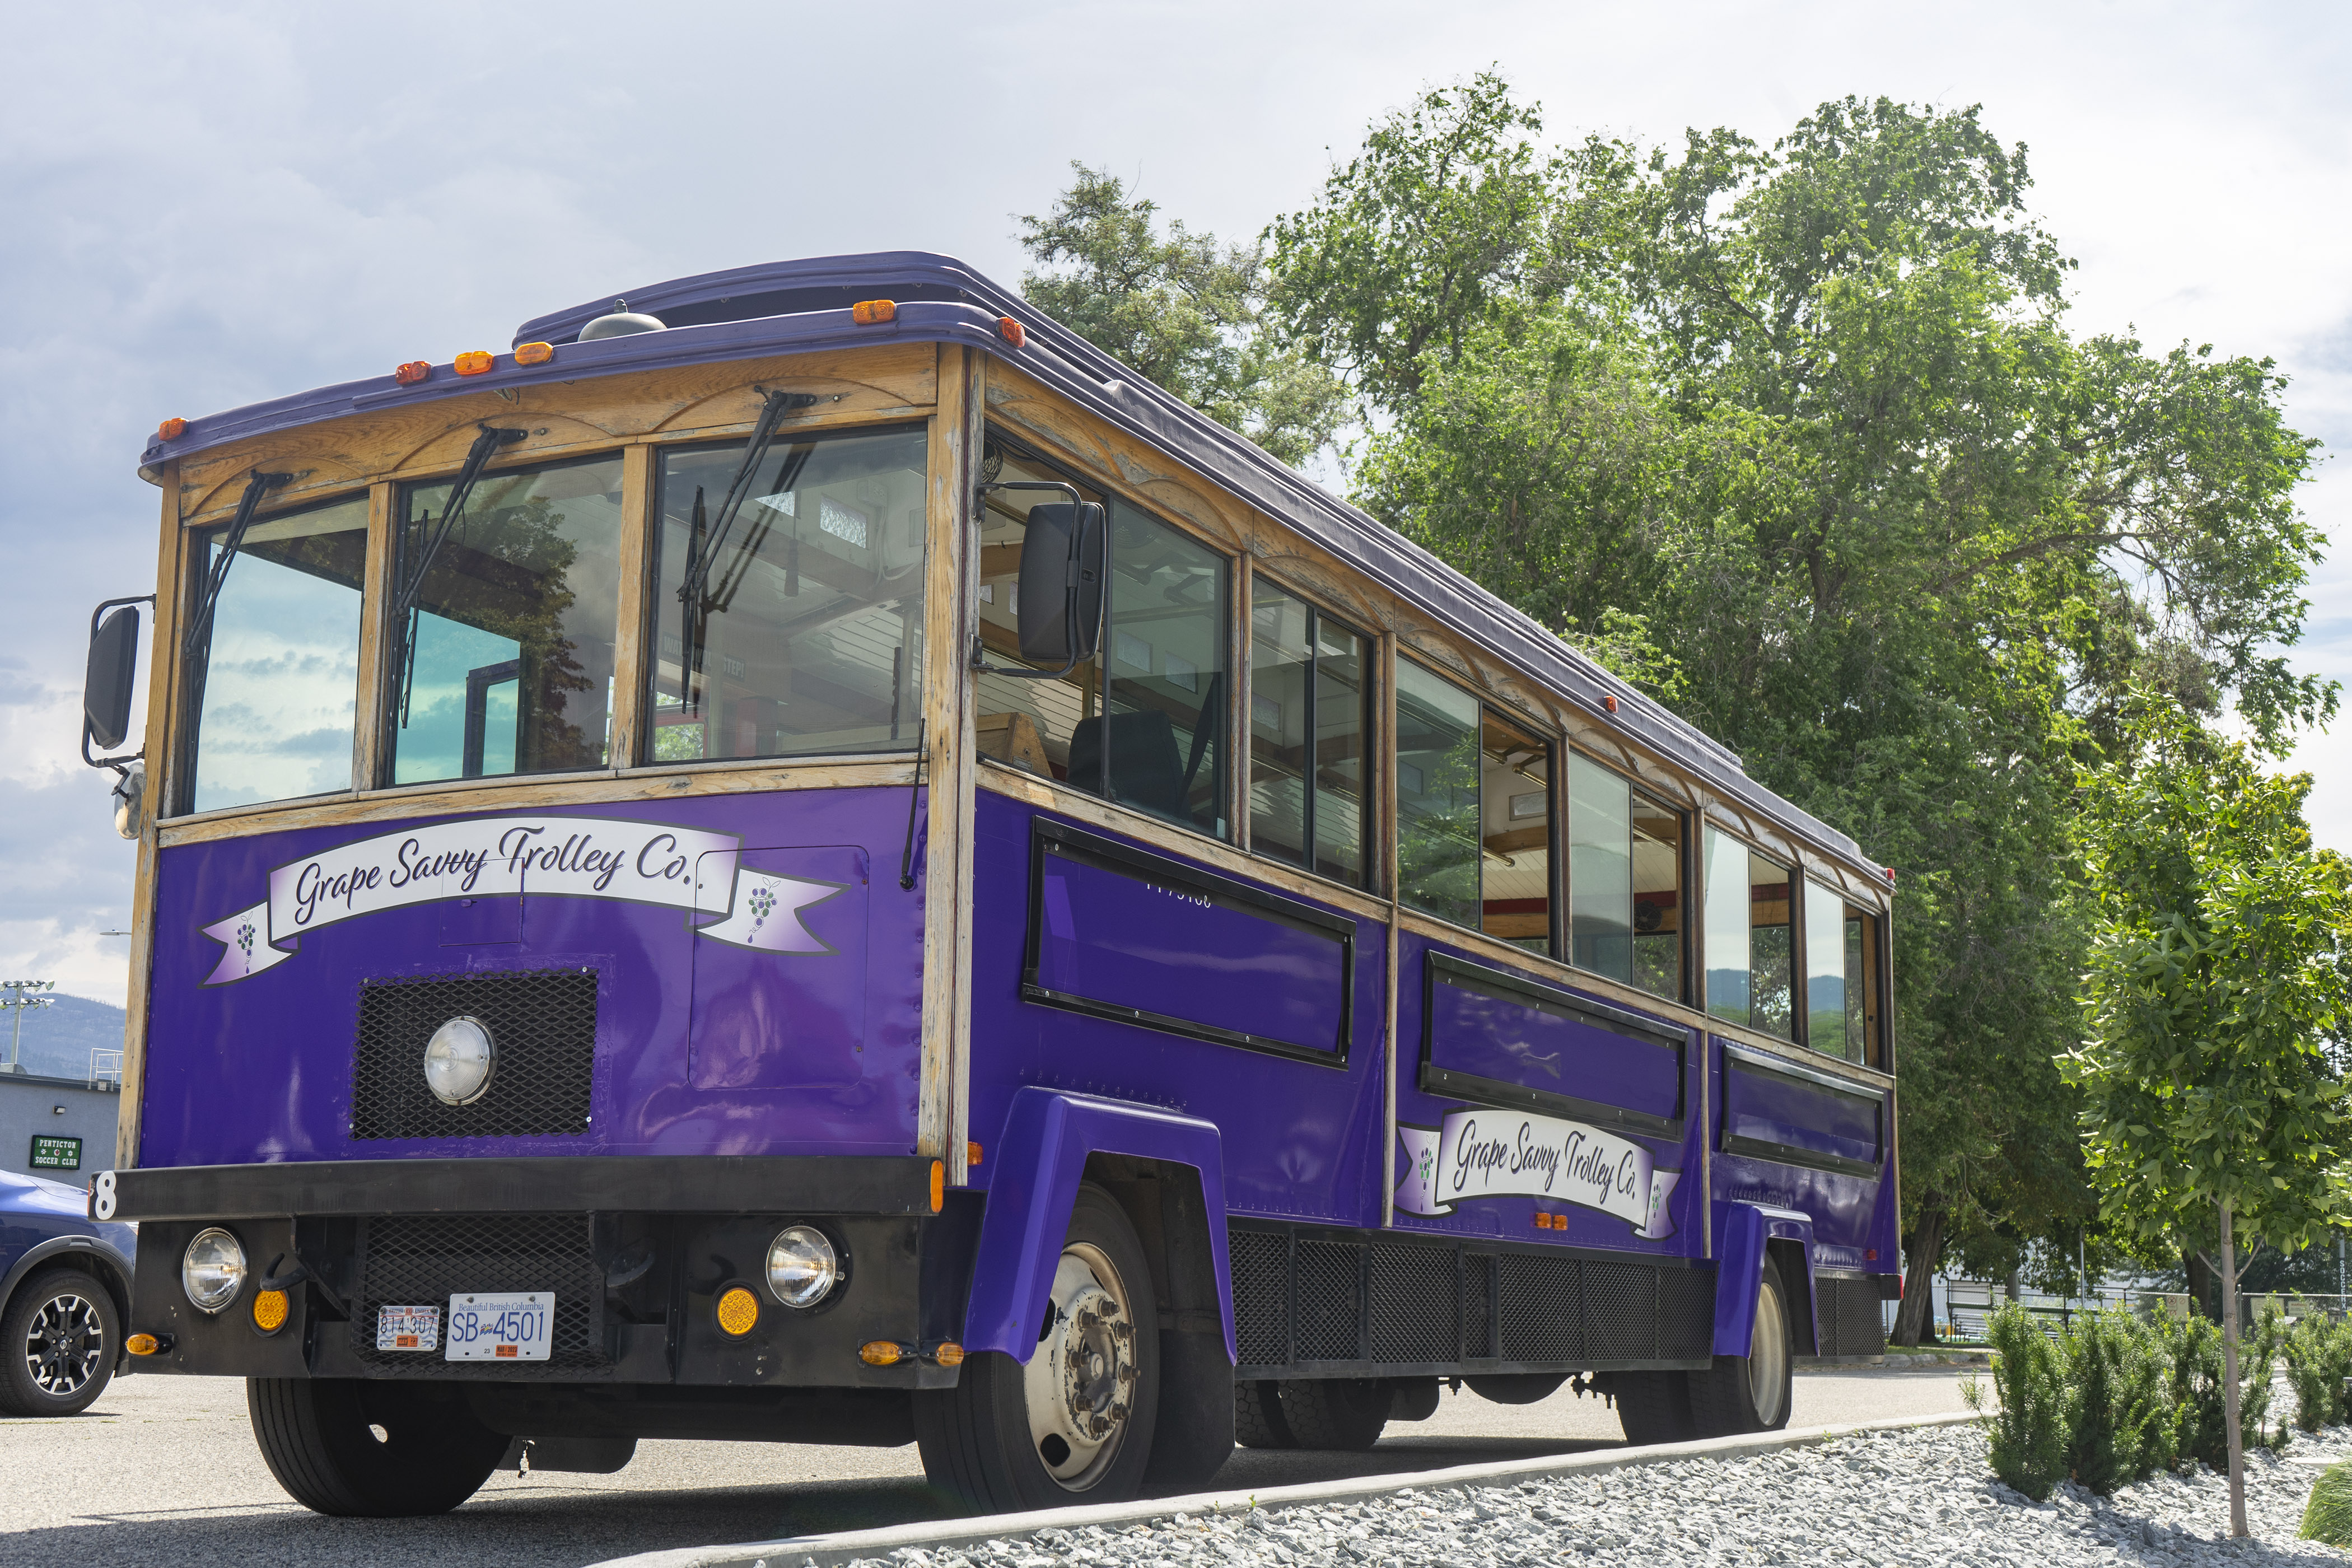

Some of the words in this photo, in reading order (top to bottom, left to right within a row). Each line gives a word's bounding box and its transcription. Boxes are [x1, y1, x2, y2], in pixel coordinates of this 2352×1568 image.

[294, 863, 382, 926] Grape
[389, 838, 488, 892] Savvy
[498, 826, 626, 892] Trolley
[637, 834, 690, 885] Co.
[39, 1139, 76, 1149] PENTICTON
[35, 1156, 58, 1165] SOCCER
[1454, 1119, 1508, 1191] Grape
[1511, 1121, 1560, 1192] Savvy
[1565, 1130, 1615, 1205] Trolley
[1617, 1150, 1636, 1200] Co.
[95, 1170, 116, 1220] 8
[459, 1303, 488, 1312] Beautiful
[489, 1303, 510, 1311] British
[512, 1301, 544, 1310] Columbia
[451, 1312, 478, 1342] SB
[492, 1312, 544, 1342] 4501
